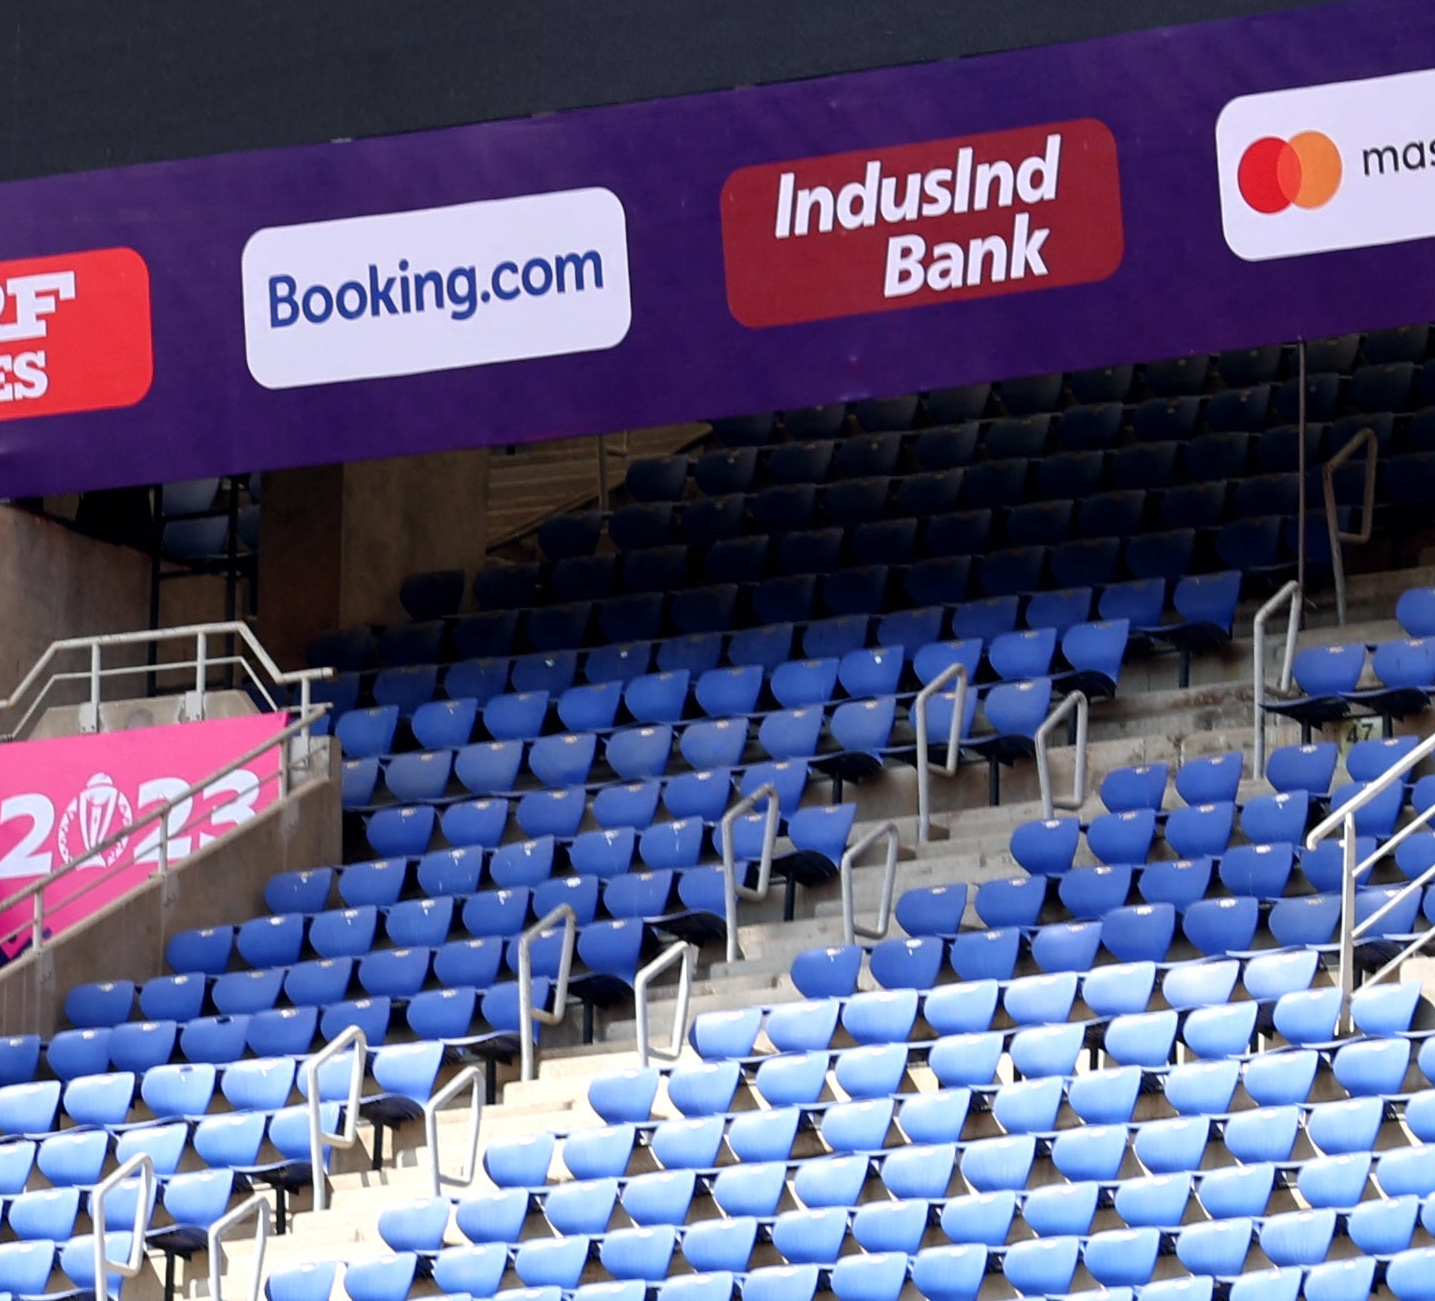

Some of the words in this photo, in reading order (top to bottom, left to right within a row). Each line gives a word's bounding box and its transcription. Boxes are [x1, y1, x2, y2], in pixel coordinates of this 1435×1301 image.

[774, 133, 1062, 239] IndusInd
[268, 249, 605, 329] Booking.com
[883, 212, 1050, 298] Bank
